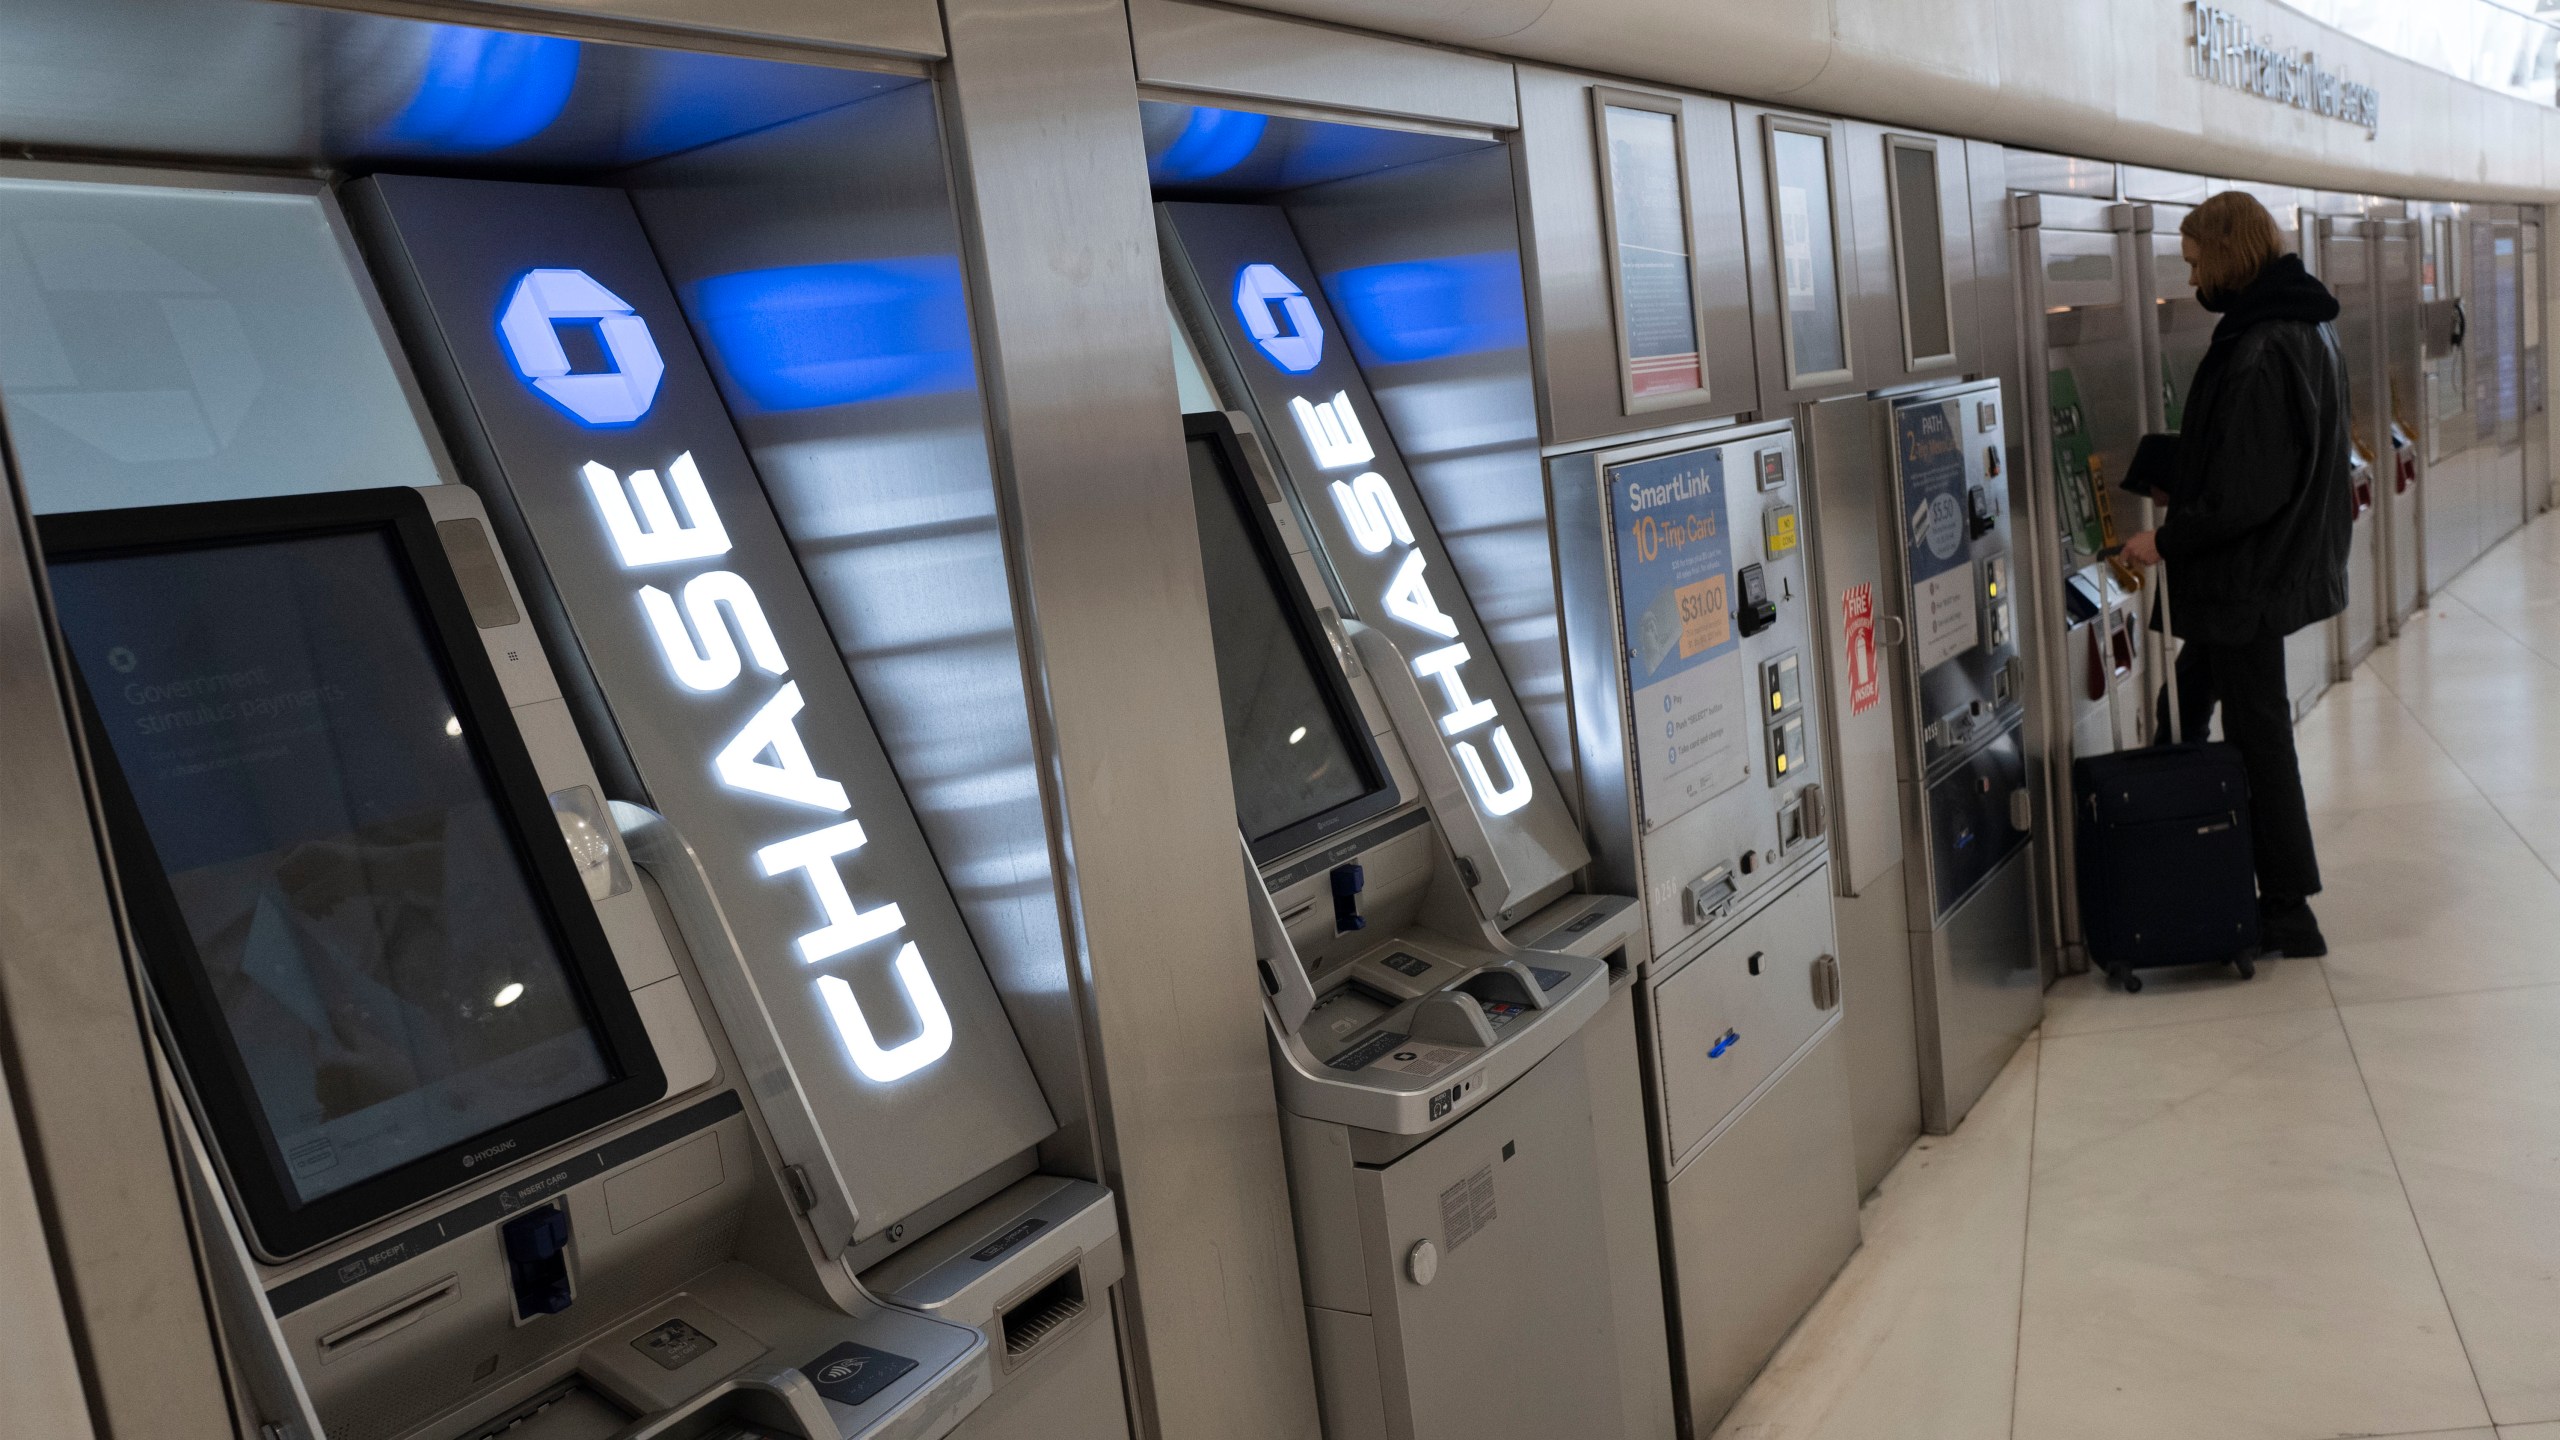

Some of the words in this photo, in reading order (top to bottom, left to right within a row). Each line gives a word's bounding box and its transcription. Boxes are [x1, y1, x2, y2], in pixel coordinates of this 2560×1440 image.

[2195, 1, 2247, 90] PATH
[1922, 414, 1943, 435] PATH
[1629, 468, 1711, 512] SmartLink
[1783, 519, 1791, 529] NO
[1932, 499, 1953, 523] $5.50
[1632, 515, 1686, 563] 10-Trip
[1687, 511, 1715, 543] Card
[1782, 535, 1794, 547] COINS
[1292, 390, 1532, 816] CHASE
[1681, 586, 1722, 624] $31.00
[1848, 596, 1867, 618] FIRE
[124, 666, 272, 707] Government
[1854, 682, 1875, 703] INSIDE
[135, 701, 236, 736] stimulus
[239, 683, 346, 722] payments
[582, 450, 952, 1083] CHASE
[473, 1138, 517, 1164] HYOSUNG
[518, 1178, 545, 1198] INSERT
[545, 1171, 567, 1188] CARD
[368, 1242, 405, 1265] RECEIPT
